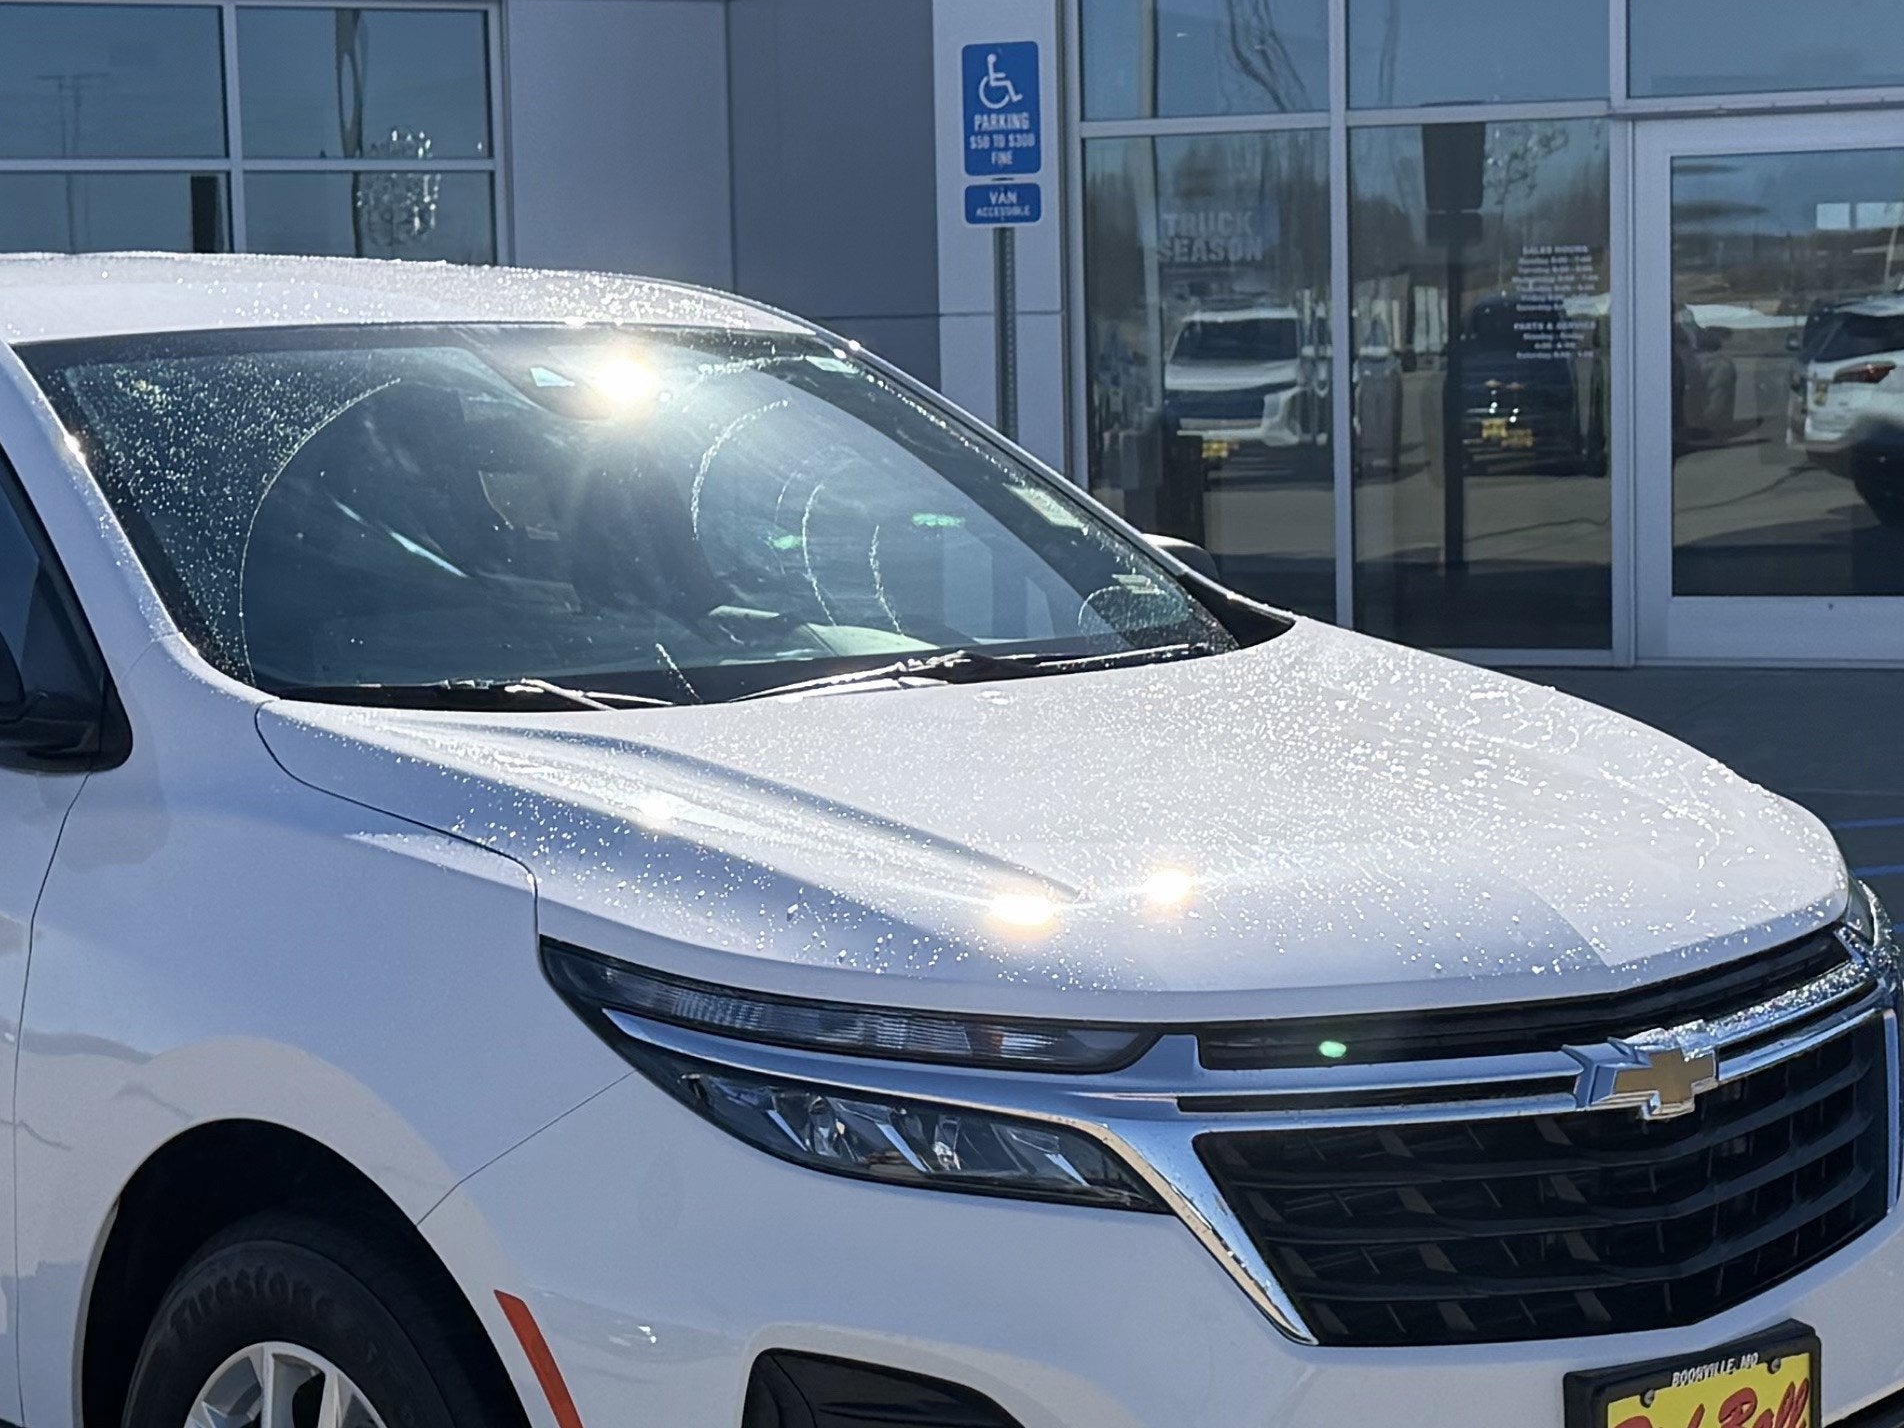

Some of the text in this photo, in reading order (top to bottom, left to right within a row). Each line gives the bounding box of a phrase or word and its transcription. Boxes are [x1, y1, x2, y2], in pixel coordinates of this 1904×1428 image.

[974, 112, 1030, 131] PARKING
[970, 133, 1035, 150] $50 TO $300
[989, 191, 1018, 205] VAN
[1160, 211, 1253, 238] TRUCK
[1158, 236, 1264, 263] SEASON
[1740, 1352, 1759, 1371] MO
